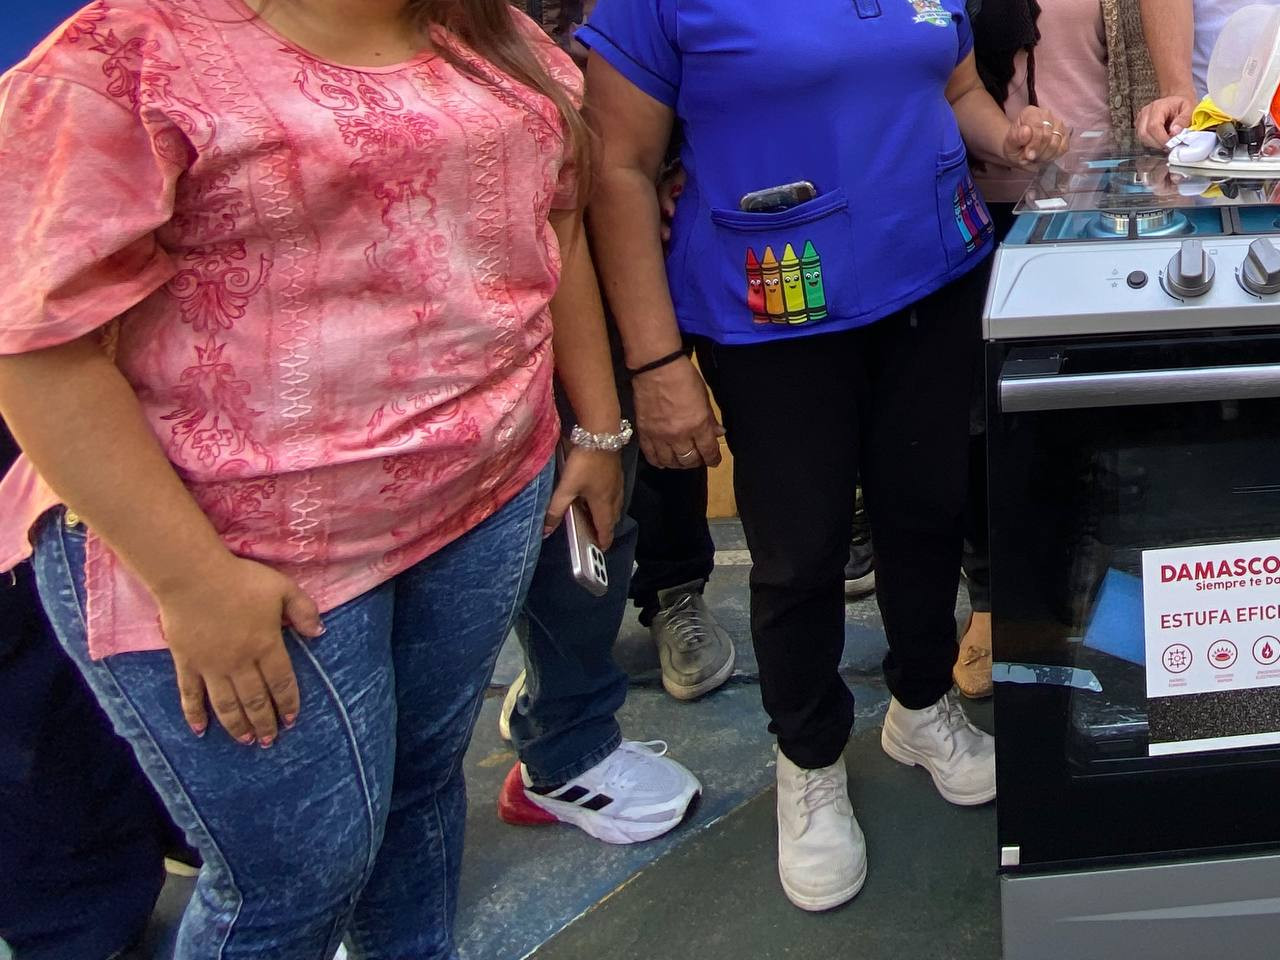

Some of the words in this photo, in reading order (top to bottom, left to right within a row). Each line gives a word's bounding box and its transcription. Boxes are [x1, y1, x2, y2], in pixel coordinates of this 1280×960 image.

[1160, 555, 1280, 583] DAMASCO
[1195, 578, 1247, 592] Siempre
[1249, 577, 1262, 587] te
[1160, 609, 1232, 629] ESTUFA
